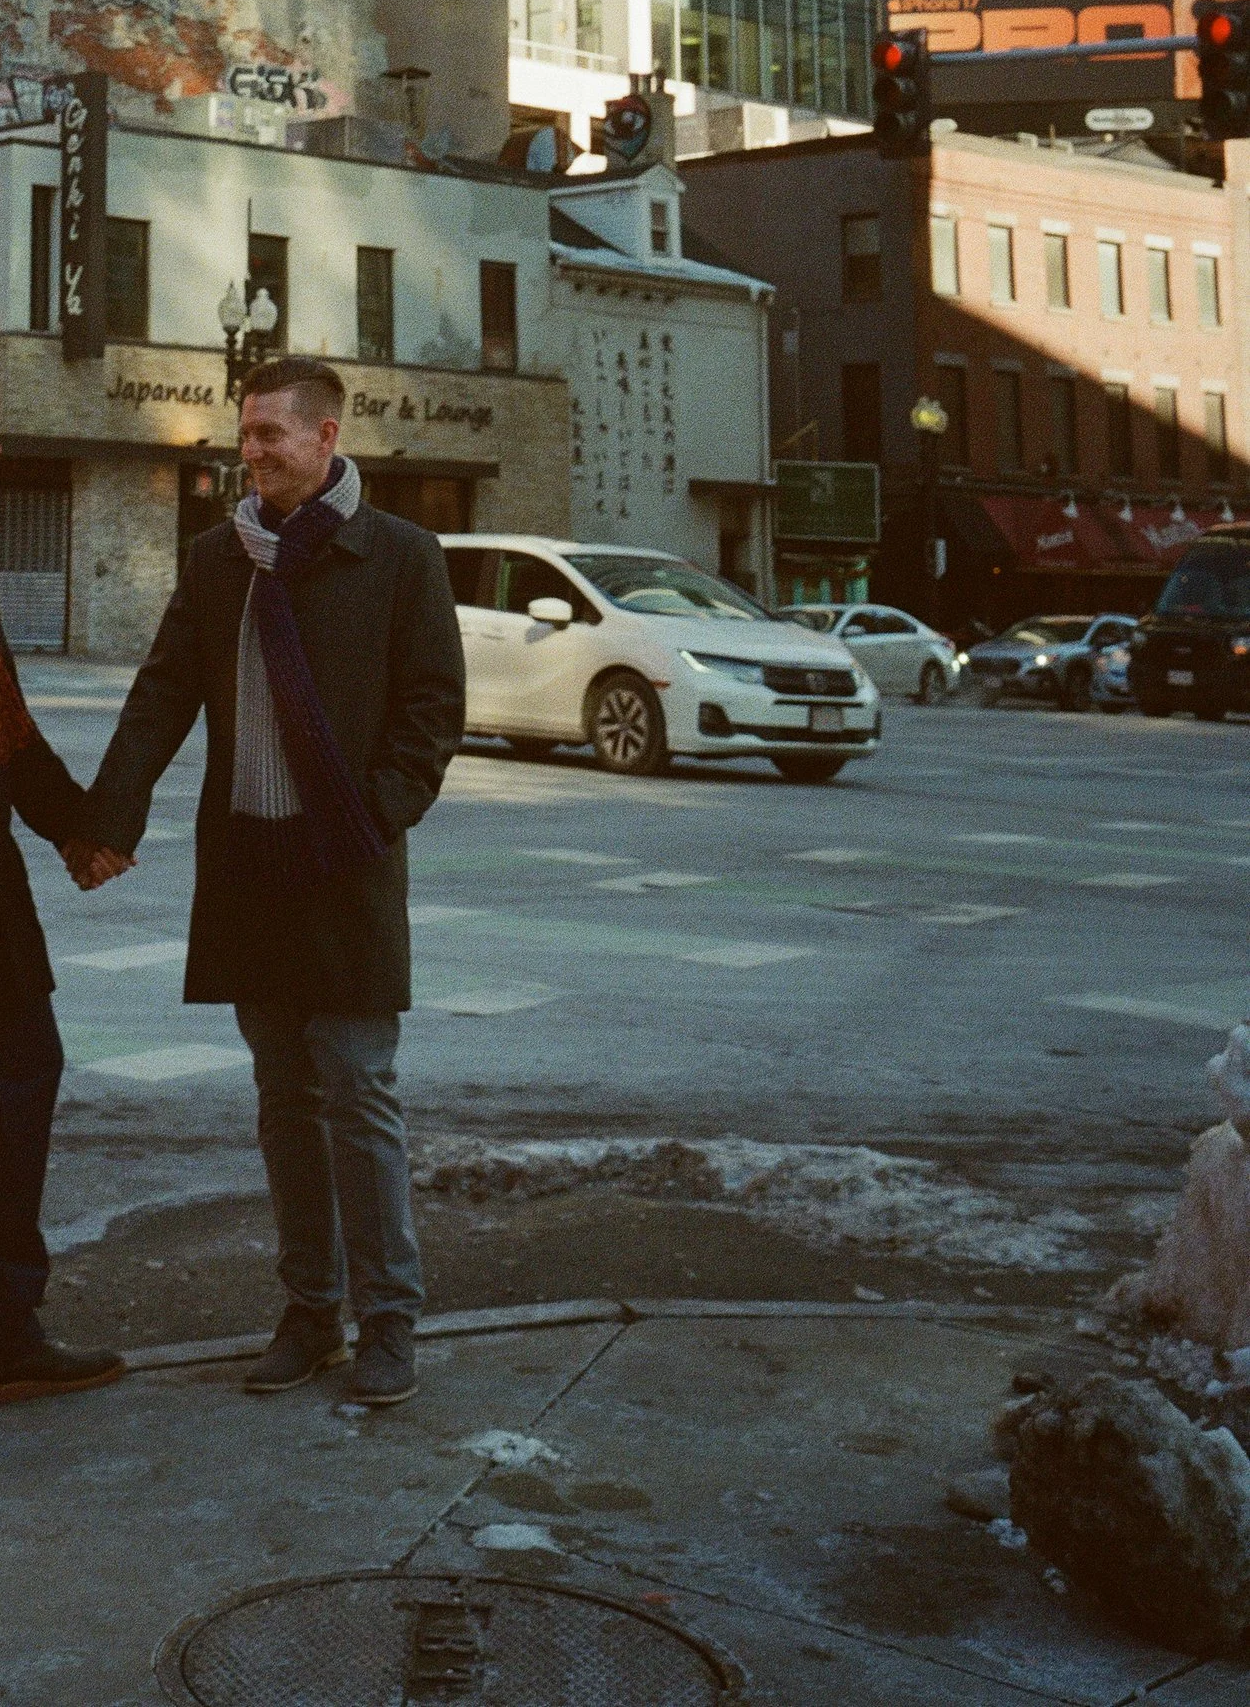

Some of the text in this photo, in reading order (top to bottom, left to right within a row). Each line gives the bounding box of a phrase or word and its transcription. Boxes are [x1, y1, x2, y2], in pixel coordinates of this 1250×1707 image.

[64, 97, 88, 241] Genki
[106, 374, 215, 411] Japanese
[352, 390, 494, 432] Bar & Lounge
